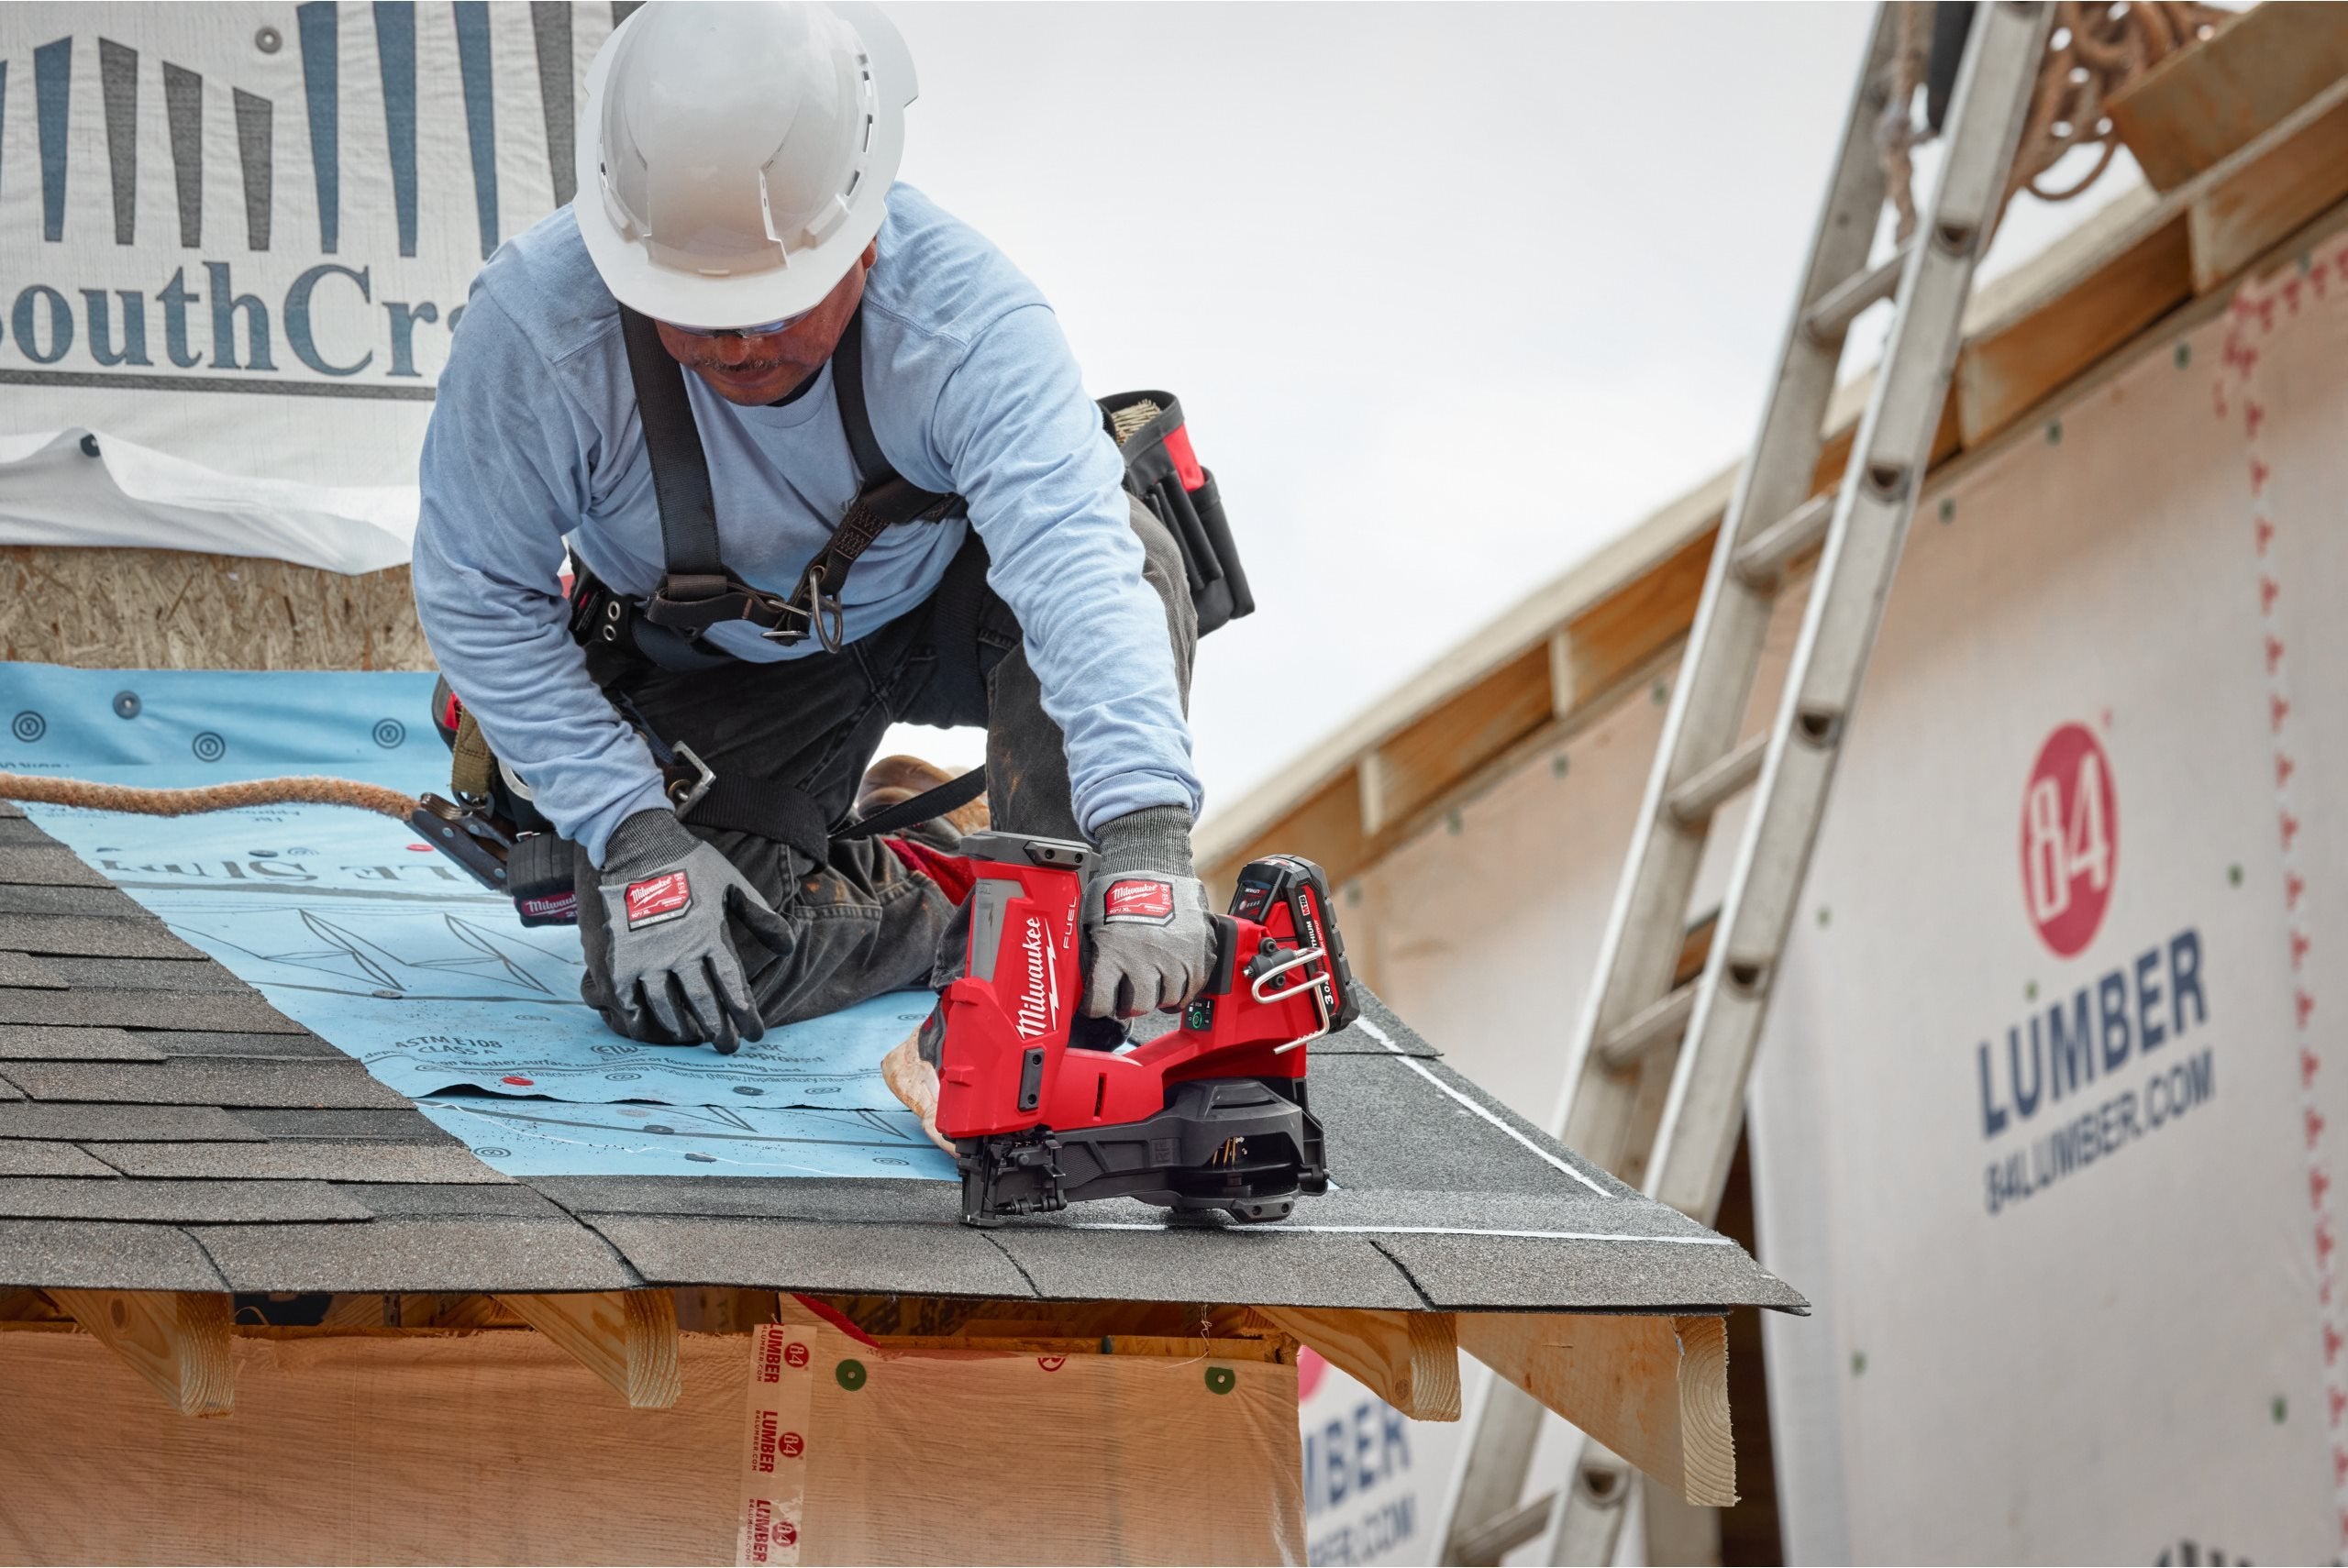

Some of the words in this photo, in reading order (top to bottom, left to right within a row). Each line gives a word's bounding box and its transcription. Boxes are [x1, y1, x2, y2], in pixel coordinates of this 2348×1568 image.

[0, 260, 467, 378] outhCr
[2027, 750, 2110, 925] 84
[525, 894, 576, 912] Milwauk
[630, 878, 673, 902] Milwaukee
[1112, 884, 1157, 900] Milwaukee
[1299, 895, 1310, 916] M18
[1062, 896, 1077, 949] FUEL
[1015, 916, 1047, 1040] Milwaukee
[394, 1035, 450, 1049] ASTM
[418, 1044, 478, 1055] CLASS
[1977, 925, 2209, 1142] LUMBER
[727, 1063, 768, 1073] being
[1984, 1045, 2217, 1216] 84LUMBER.COM
[757, 1325, 767, 1382] 4LUMBER.COM
[764, 1323, 784, 1383] LUMBER
[788, 1344, 805, 1365] 84
[751, 1410, 761, 1471] 84LUMBER.COM
[759, 1410, 778, 1473] LUMBER
[782, 1433, 800, 1455] 84
[745, 1498, 755, 1561] 84LUMBER.COM
[752, 1499, 771, 1562] LUMBER
[776, 1522, 792, 1545] 84
